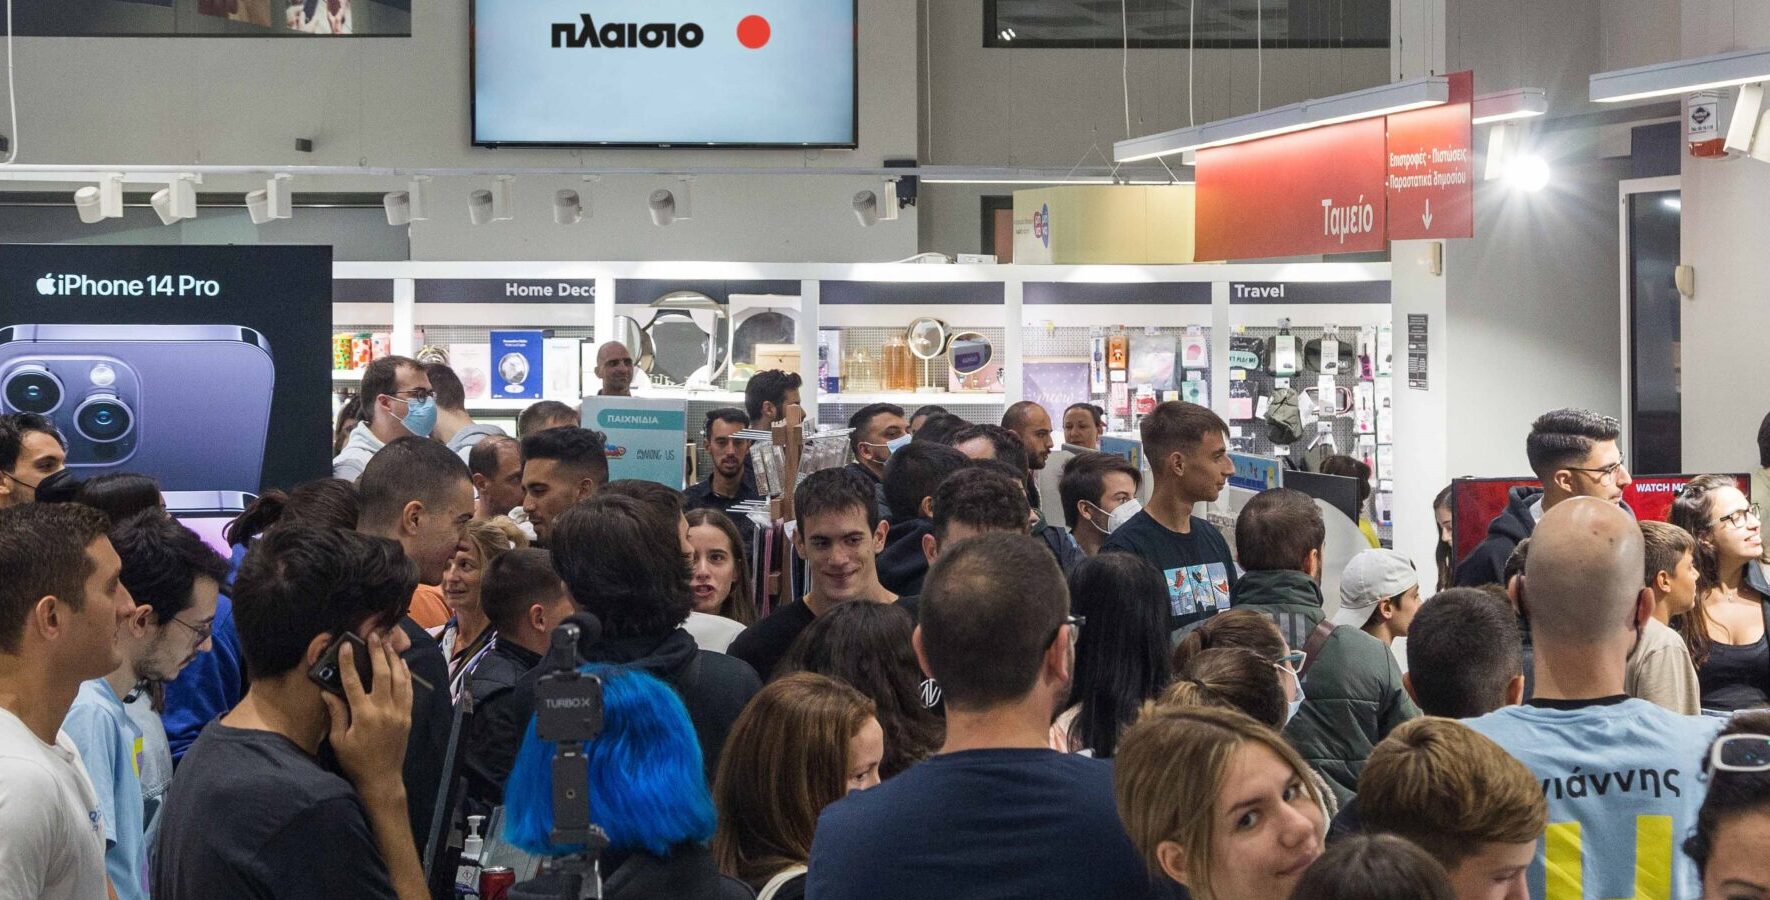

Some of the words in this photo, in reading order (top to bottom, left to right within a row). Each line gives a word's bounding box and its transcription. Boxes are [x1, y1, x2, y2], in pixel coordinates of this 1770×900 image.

[1390, 147, 1427, 170] Επιστροφές
[1432, 144, 1467, 163] Πιστώσεις
[1390, 169, 1432, 192] Παραστατικά
[1321, 194, 1374, 244] Ταμείο
[57, 274, 144, 296] iPhone
[146, 275, 175, 296] 14
[178, 275, 220, 296] Pro
[505, 282, 553, 297] Home
[1233, 284, 1285, 298] Travel
[607, 415, 659, 424] ΠΑΙΧΝΙΔΙΑ
[1635, 483, 1670, 492] WATCH
